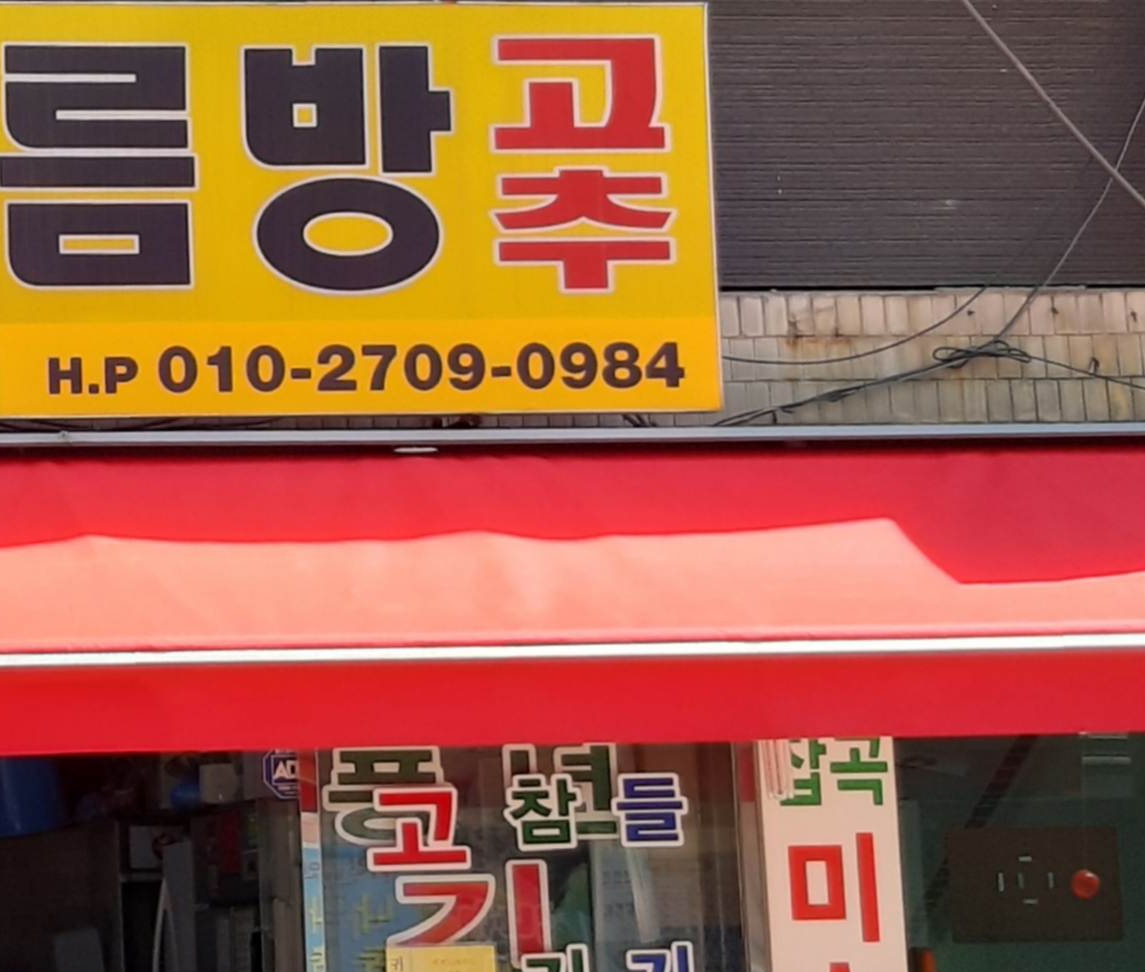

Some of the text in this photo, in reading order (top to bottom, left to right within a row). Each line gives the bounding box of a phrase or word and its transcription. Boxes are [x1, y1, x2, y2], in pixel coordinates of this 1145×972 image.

[489, 35, 674, 293] 고추
[47, 341, 685, 395] H.P 010-2709-0984
